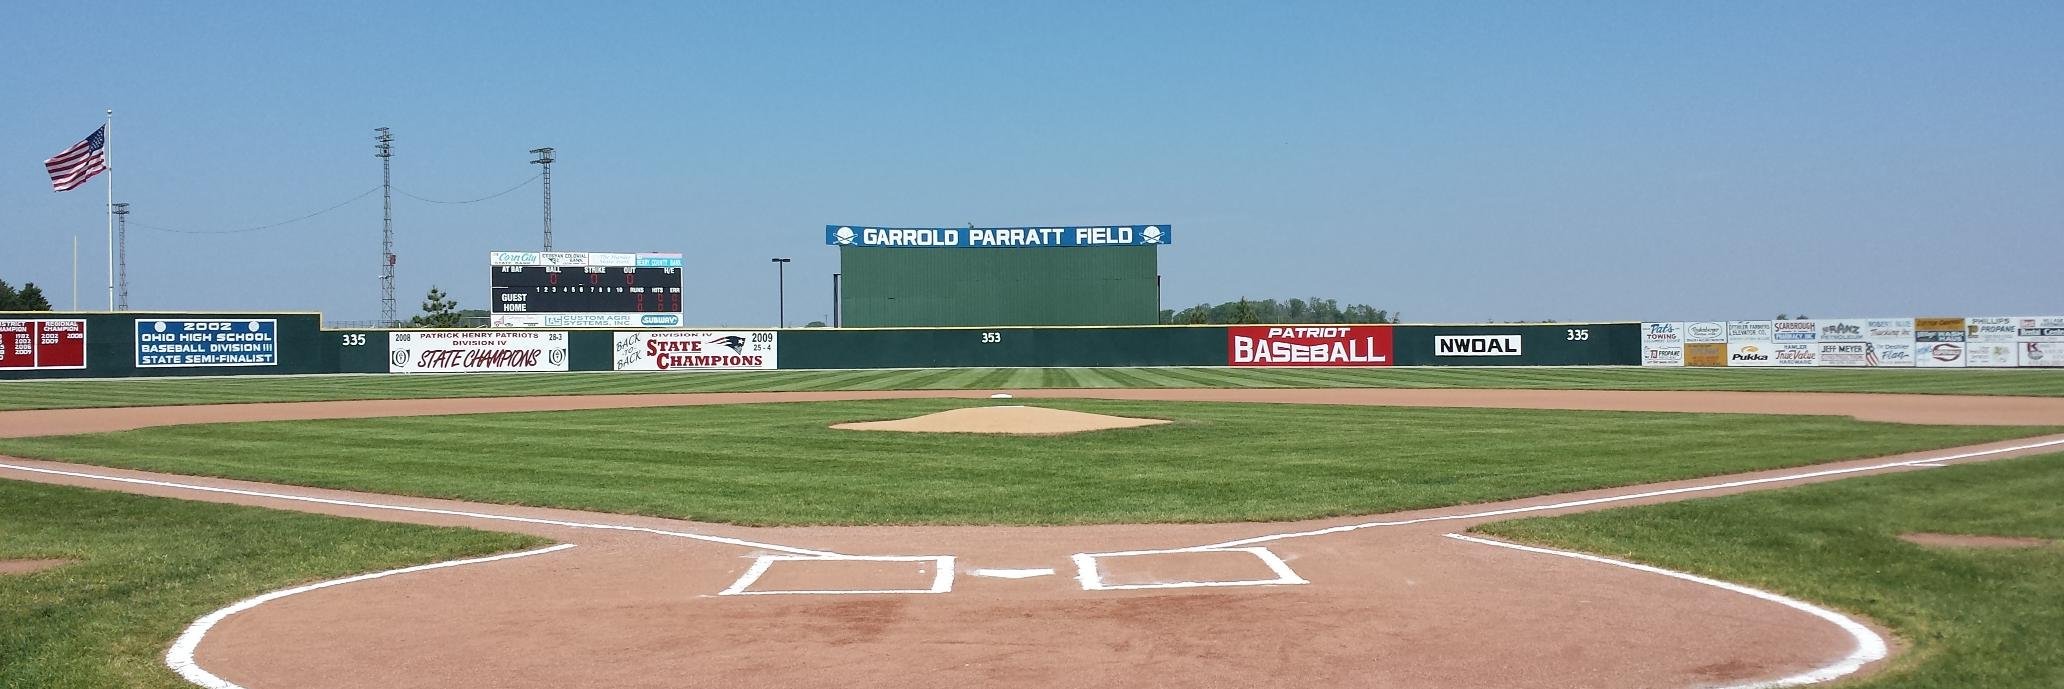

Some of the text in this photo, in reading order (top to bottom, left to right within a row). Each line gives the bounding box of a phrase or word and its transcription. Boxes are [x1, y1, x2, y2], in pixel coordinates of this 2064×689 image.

[863, 227, 1133, 246] GARROLD PARRATT FIELD
[499, 252, 521, 262] Corn
[501, 293, 527, 302] GUEST
[503, 303, 527, 312] HOME
[642, 316, 676, 324] SUBWAY
[184, 322, 232, 331] 2002
[1650, 323, 1674, 334] Pat's
[1981, 325, 2016, 333] PROPANE
[141, 332, 272, 342] OHIO HIGH SCHOOL
[395, 333, 411, 342] 2008
[751, 333, 773, 343] 2009
[981, 332, 1001, 343] 353
[1267, 327, 1351, 339] PATRIOT
[1566, 329, 1589, 341] 335
[342, 333, 367, 346] 335
[616, 332, 641, 352] BACK
[141, 343, 273, 353] BASEBALL DIVISION III
[646, 339, 702, 356] STATE
[1234, 335, 1386, 363] BASEBALL
[1440, 338, 1517, 352] NWOAL
[1821, 345, 1863, 353] JEFF MEYER
[142, 354, 273, 364] STATE SEMI-FINALIST
[417, 348, 542, 369] STATE CHAMPIONS
[616, 350, 643, 370] BACK
[656, 353, 763, 370] CHAMPIONS
[1732, 353, 1768, 361] Pukka
